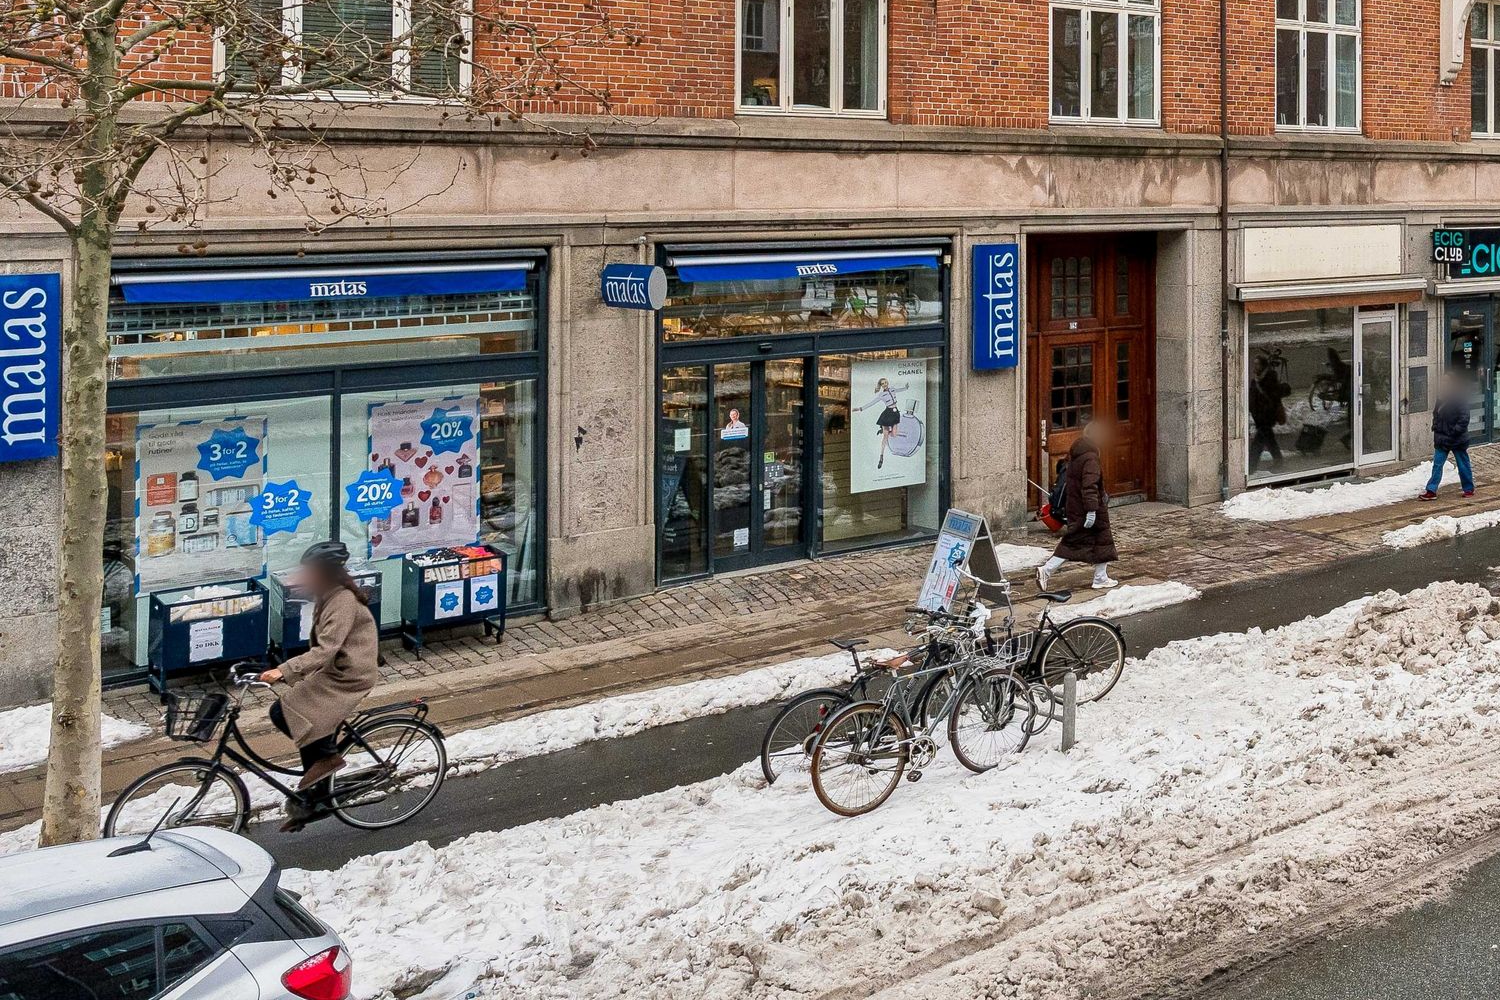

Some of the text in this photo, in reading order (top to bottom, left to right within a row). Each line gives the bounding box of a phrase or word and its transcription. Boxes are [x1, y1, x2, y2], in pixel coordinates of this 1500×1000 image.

[1434, 232, 1463, 246] ECIG
[1434, 247, 1463, 262] CLUB
[796, 263, 838, 276] matas
[310, 279, 367, 297] matas
[606, 271, 647, 305] matas
[982, 252, 1014, 359] matas
[431, 421, 463, 440] 20%
[210, 441, 248, 462] 3 for 2
[262, 492, 275, 510] 3
[287, 489, 299, 507] 2
[356, 482, 393, 503] 20%
